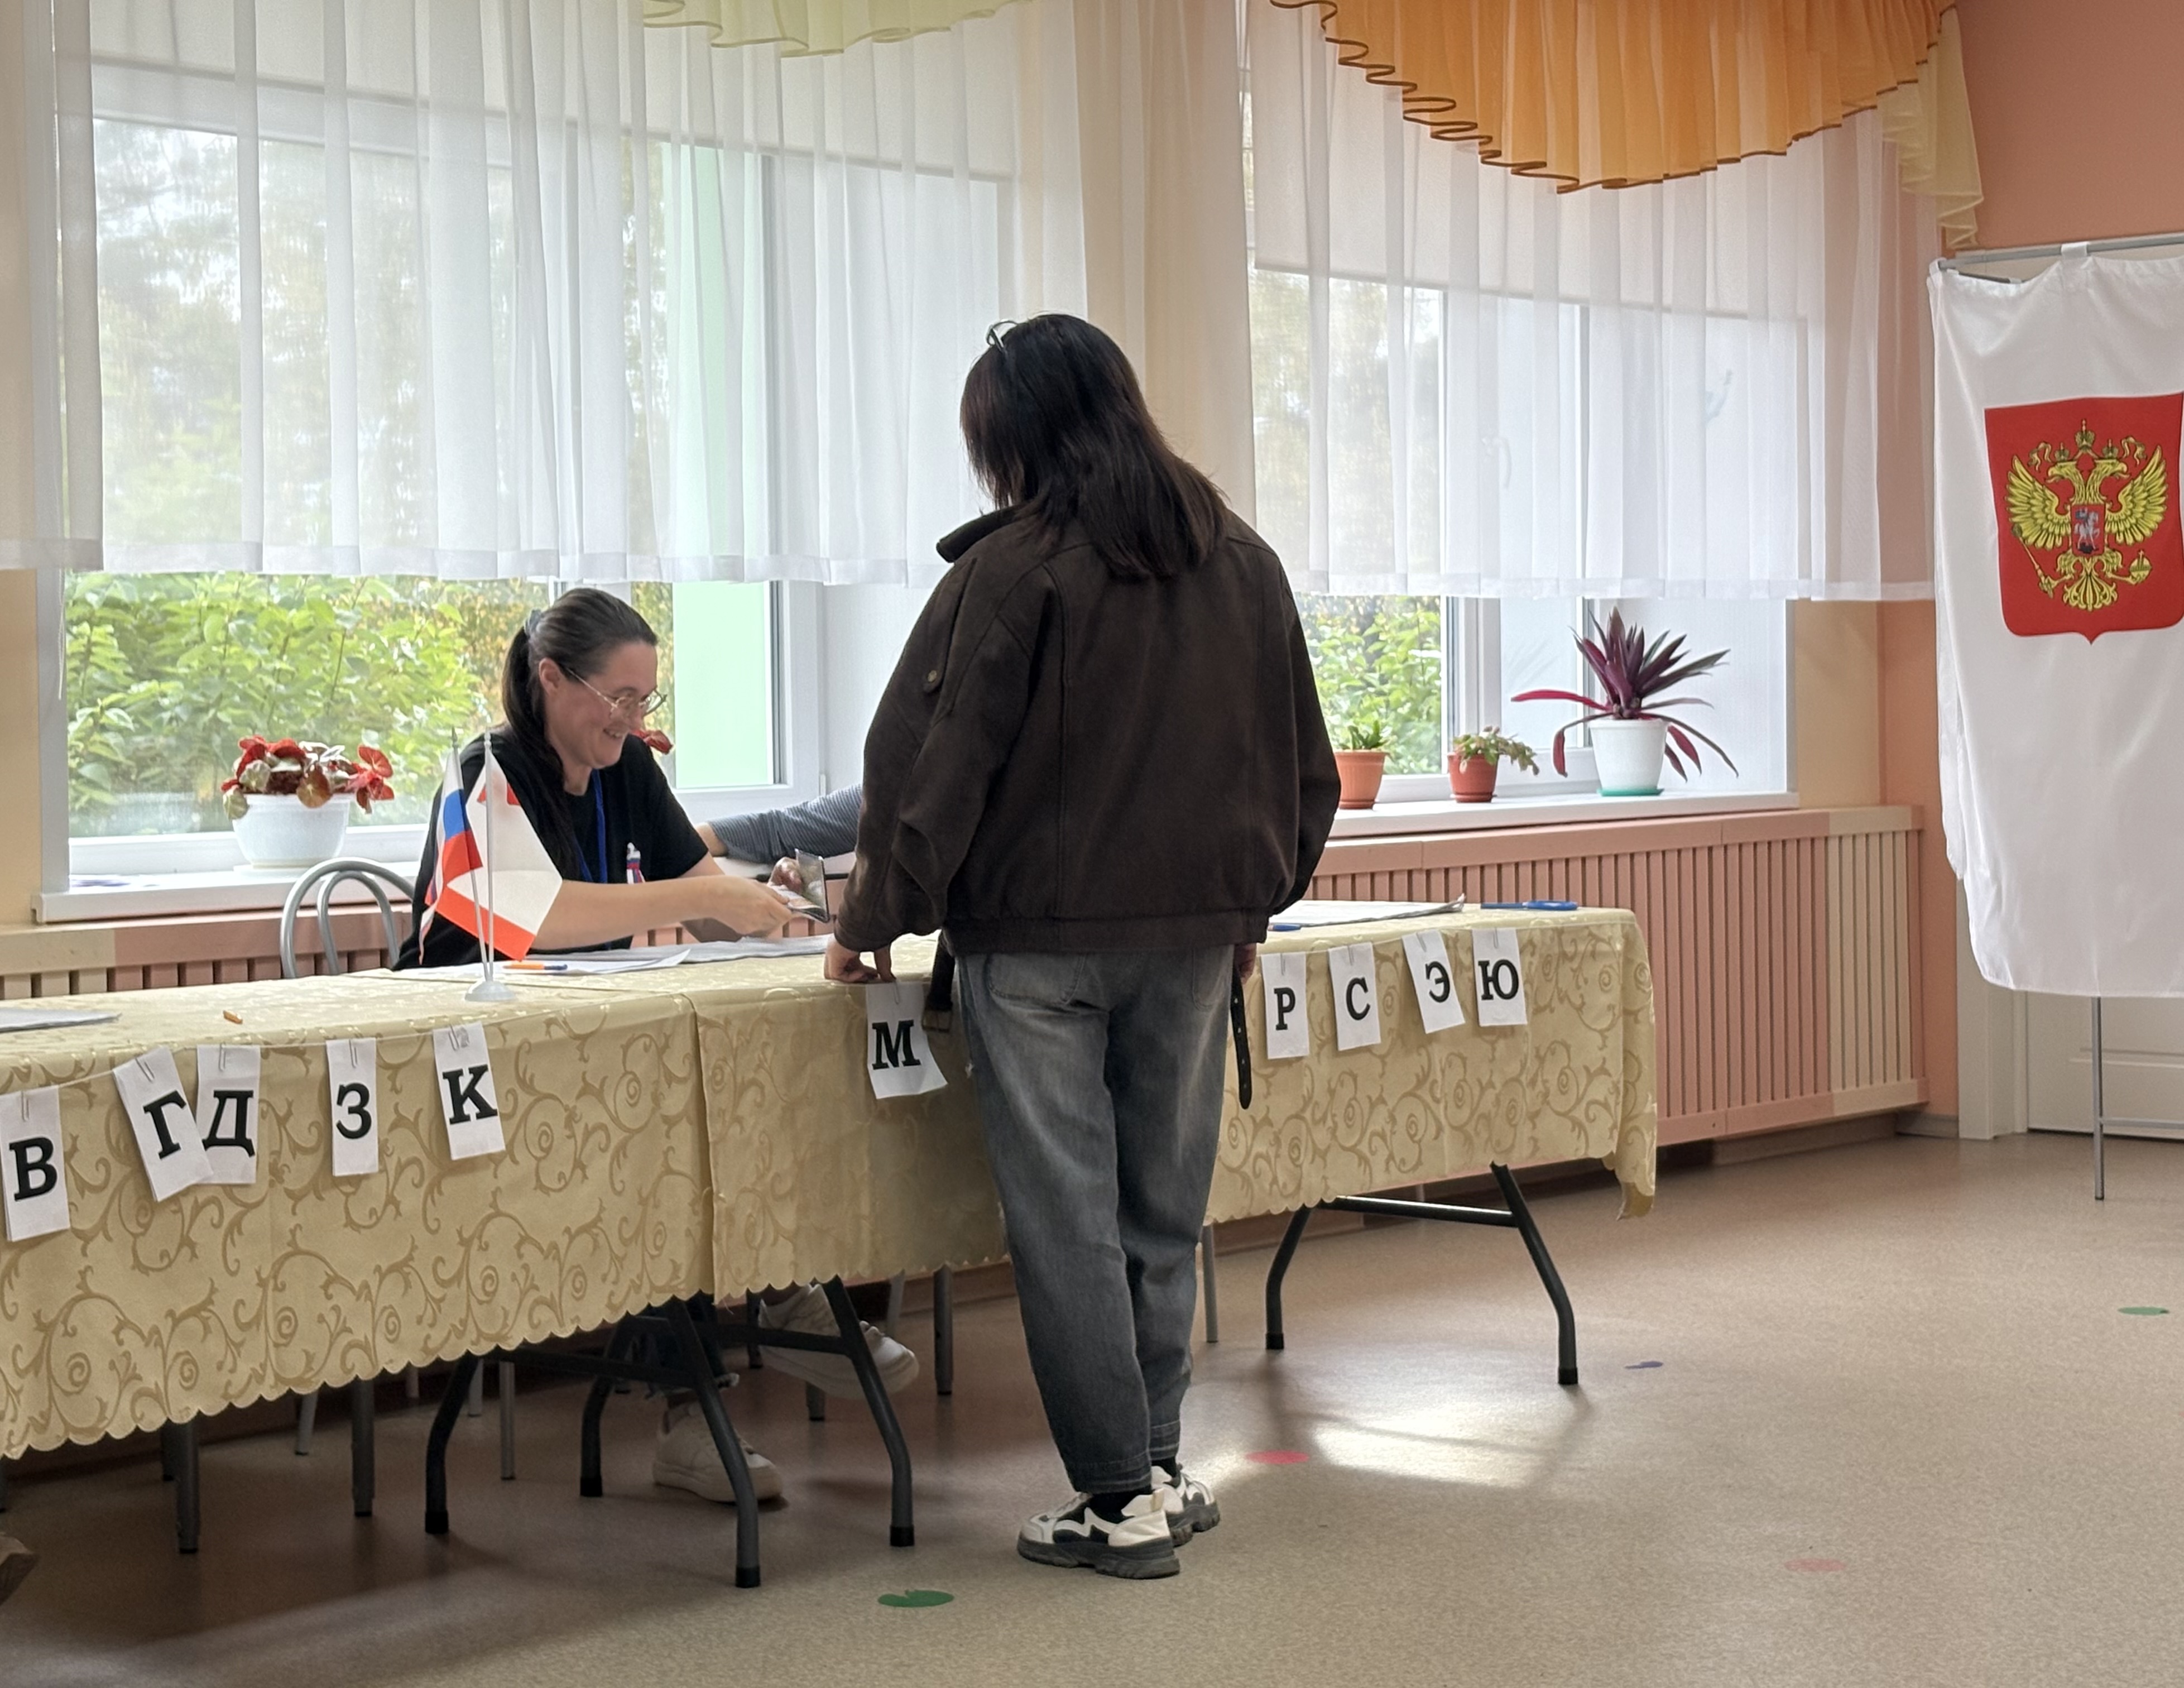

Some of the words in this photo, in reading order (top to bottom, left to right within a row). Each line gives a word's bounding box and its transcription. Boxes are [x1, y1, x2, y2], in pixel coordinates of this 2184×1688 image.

[1345, 977, 1371, 1021] С
[1425, 961, 1451, 1003] Э
[1477, 959, 1520, 1000] Ю
[1273, 987, 1296, 1031] Р
[871, 1019, 921, 1071] М
[442, 1064, 498, 1125] К
[143, 1090, 186, 1159] Г
[201, 1090, 256, 1158] Д
[9, 1137, 57, 1202] В
